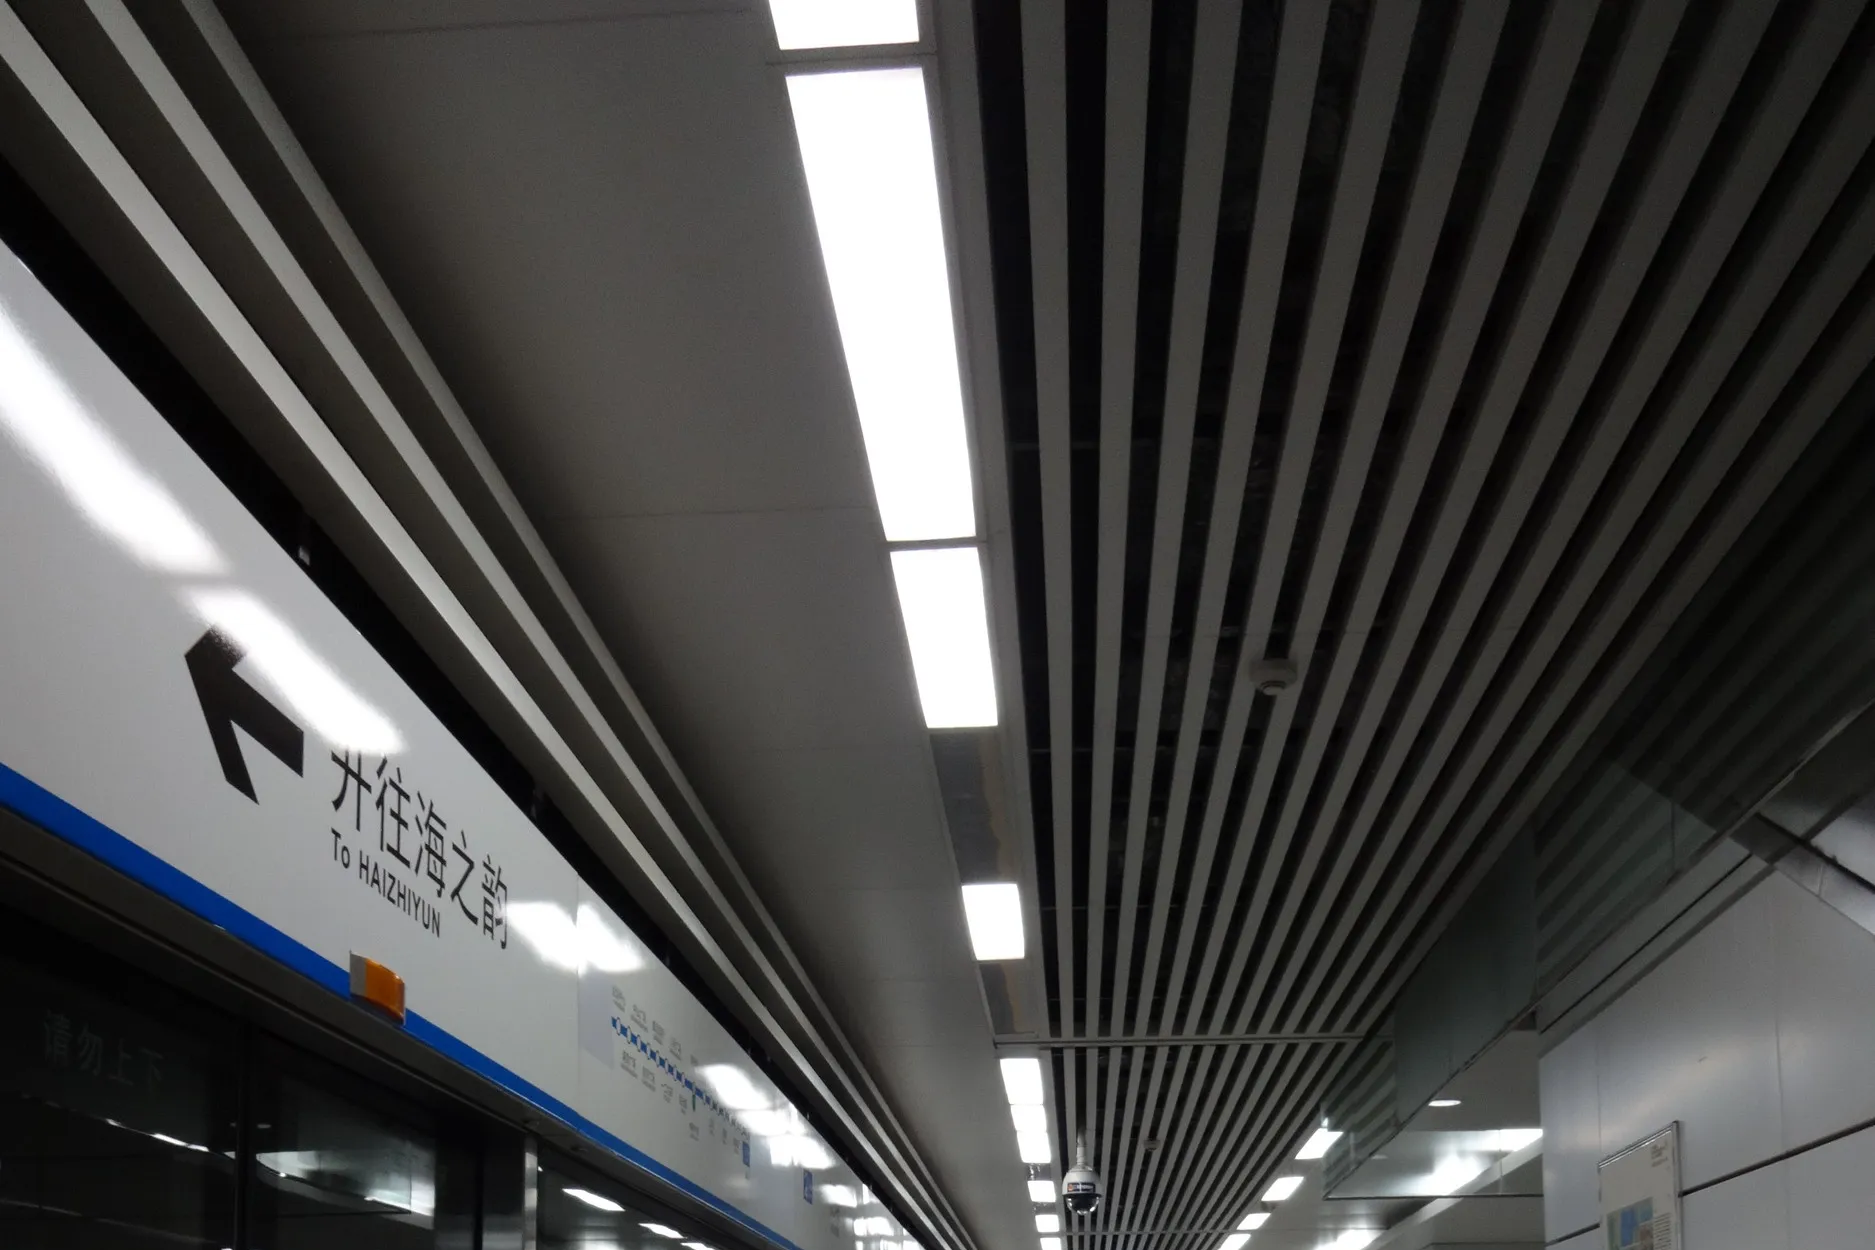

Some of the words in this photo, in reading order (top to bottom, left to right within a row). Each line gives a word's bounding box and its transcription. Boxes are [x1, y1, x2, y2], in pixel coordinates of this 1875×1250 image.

[331, 826, 351, 869] To
[359, 849, 441, 938] HAIZHIYUN
[43, 1007, 164, 1093] 请勿上下
